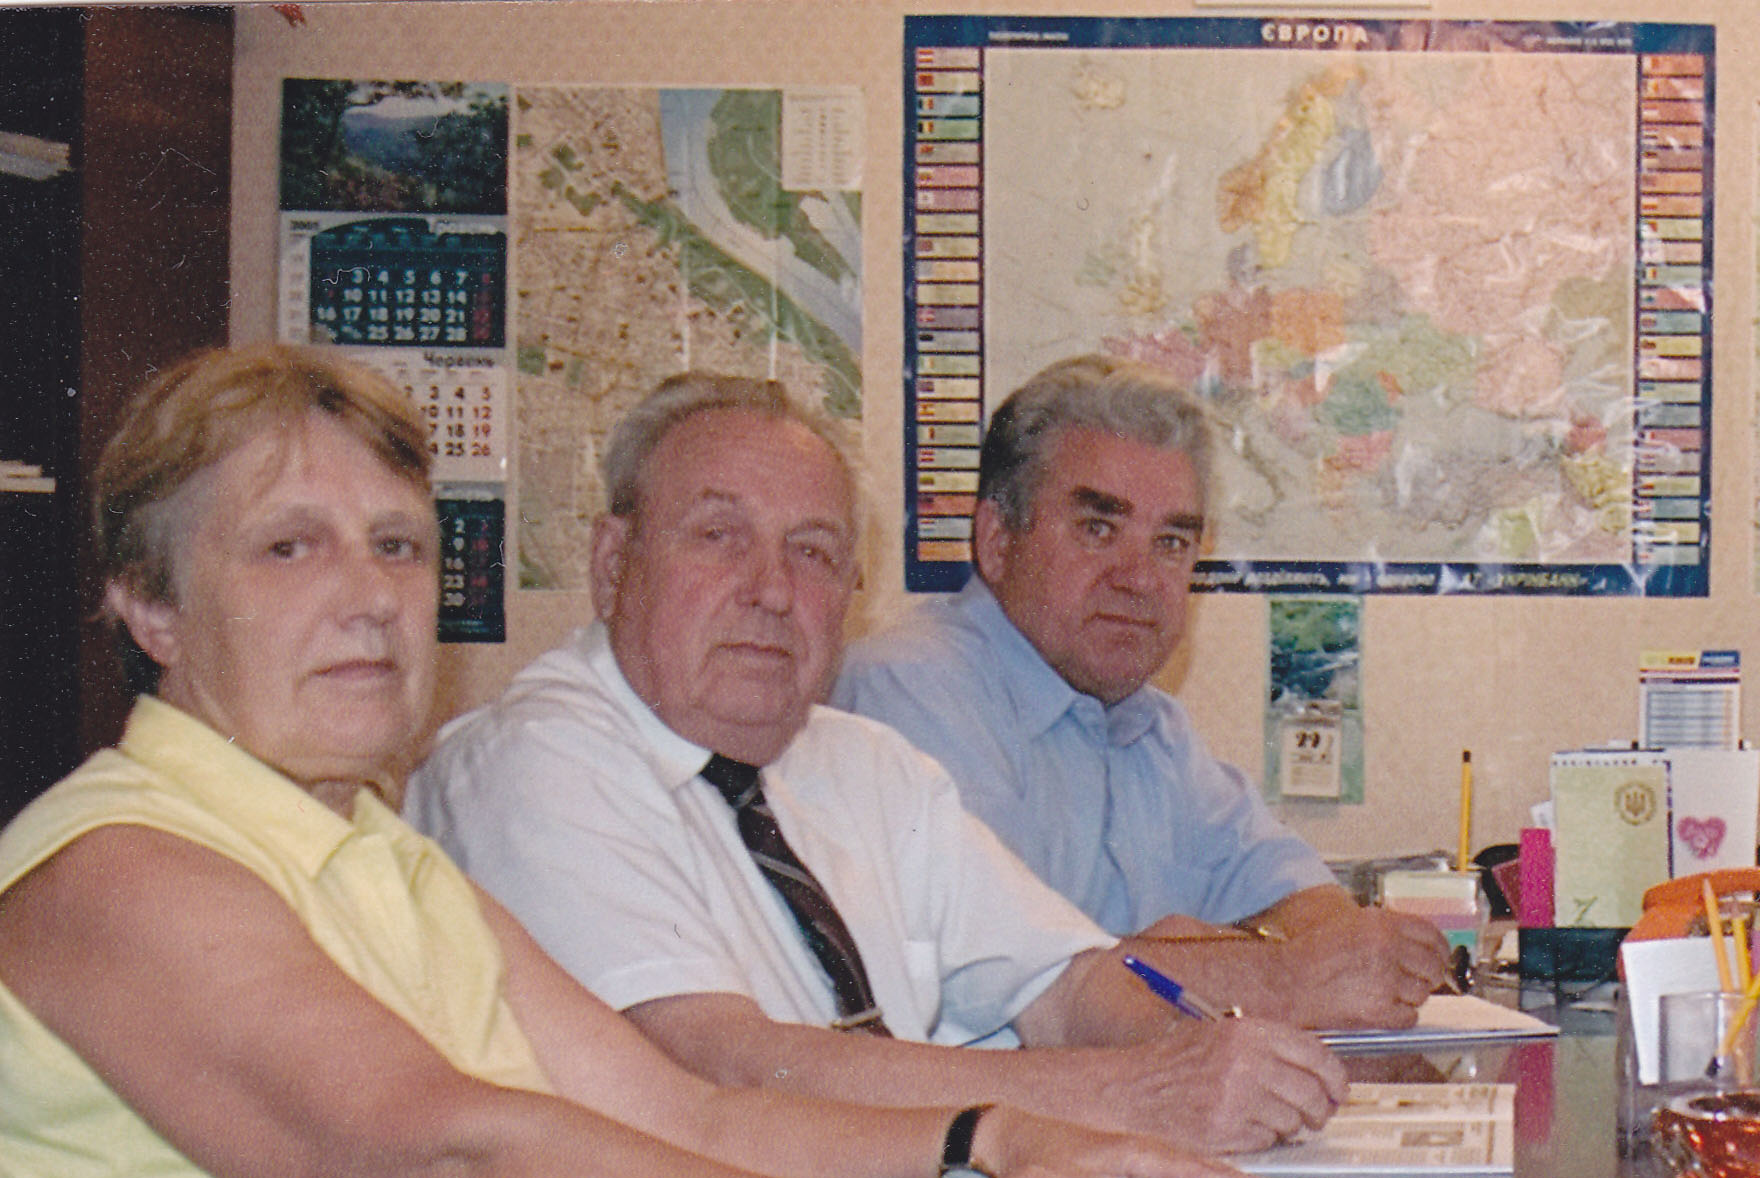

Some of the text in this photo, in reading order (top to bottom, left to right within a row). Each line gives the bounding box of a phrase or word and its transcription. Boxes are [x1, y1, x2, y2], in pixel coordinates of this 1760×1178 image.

[1260, 22, 1371, 44] ЄВРОПА
[376, 268, 390, 285] 4
[403, 268, 416, 286] 5
[430, 269, 442, 286] 6
[455, 270, 468, 286] 7
[369, 288, 388, 304] 11
[395, 287, 416, 304] 12
[421, 288, 442, 304] 13
[343, 306, 363, 321] 17
[445, 308, 466, 323] 21
[429, 383, 439, 400] 3
[454, 386, 465, 400] 4
[446, 404, 464, 418] 11
[473, 404, 492, 419] 12
[446, 422, 465, 438] 18
[445, 441, 465, 456] 25
